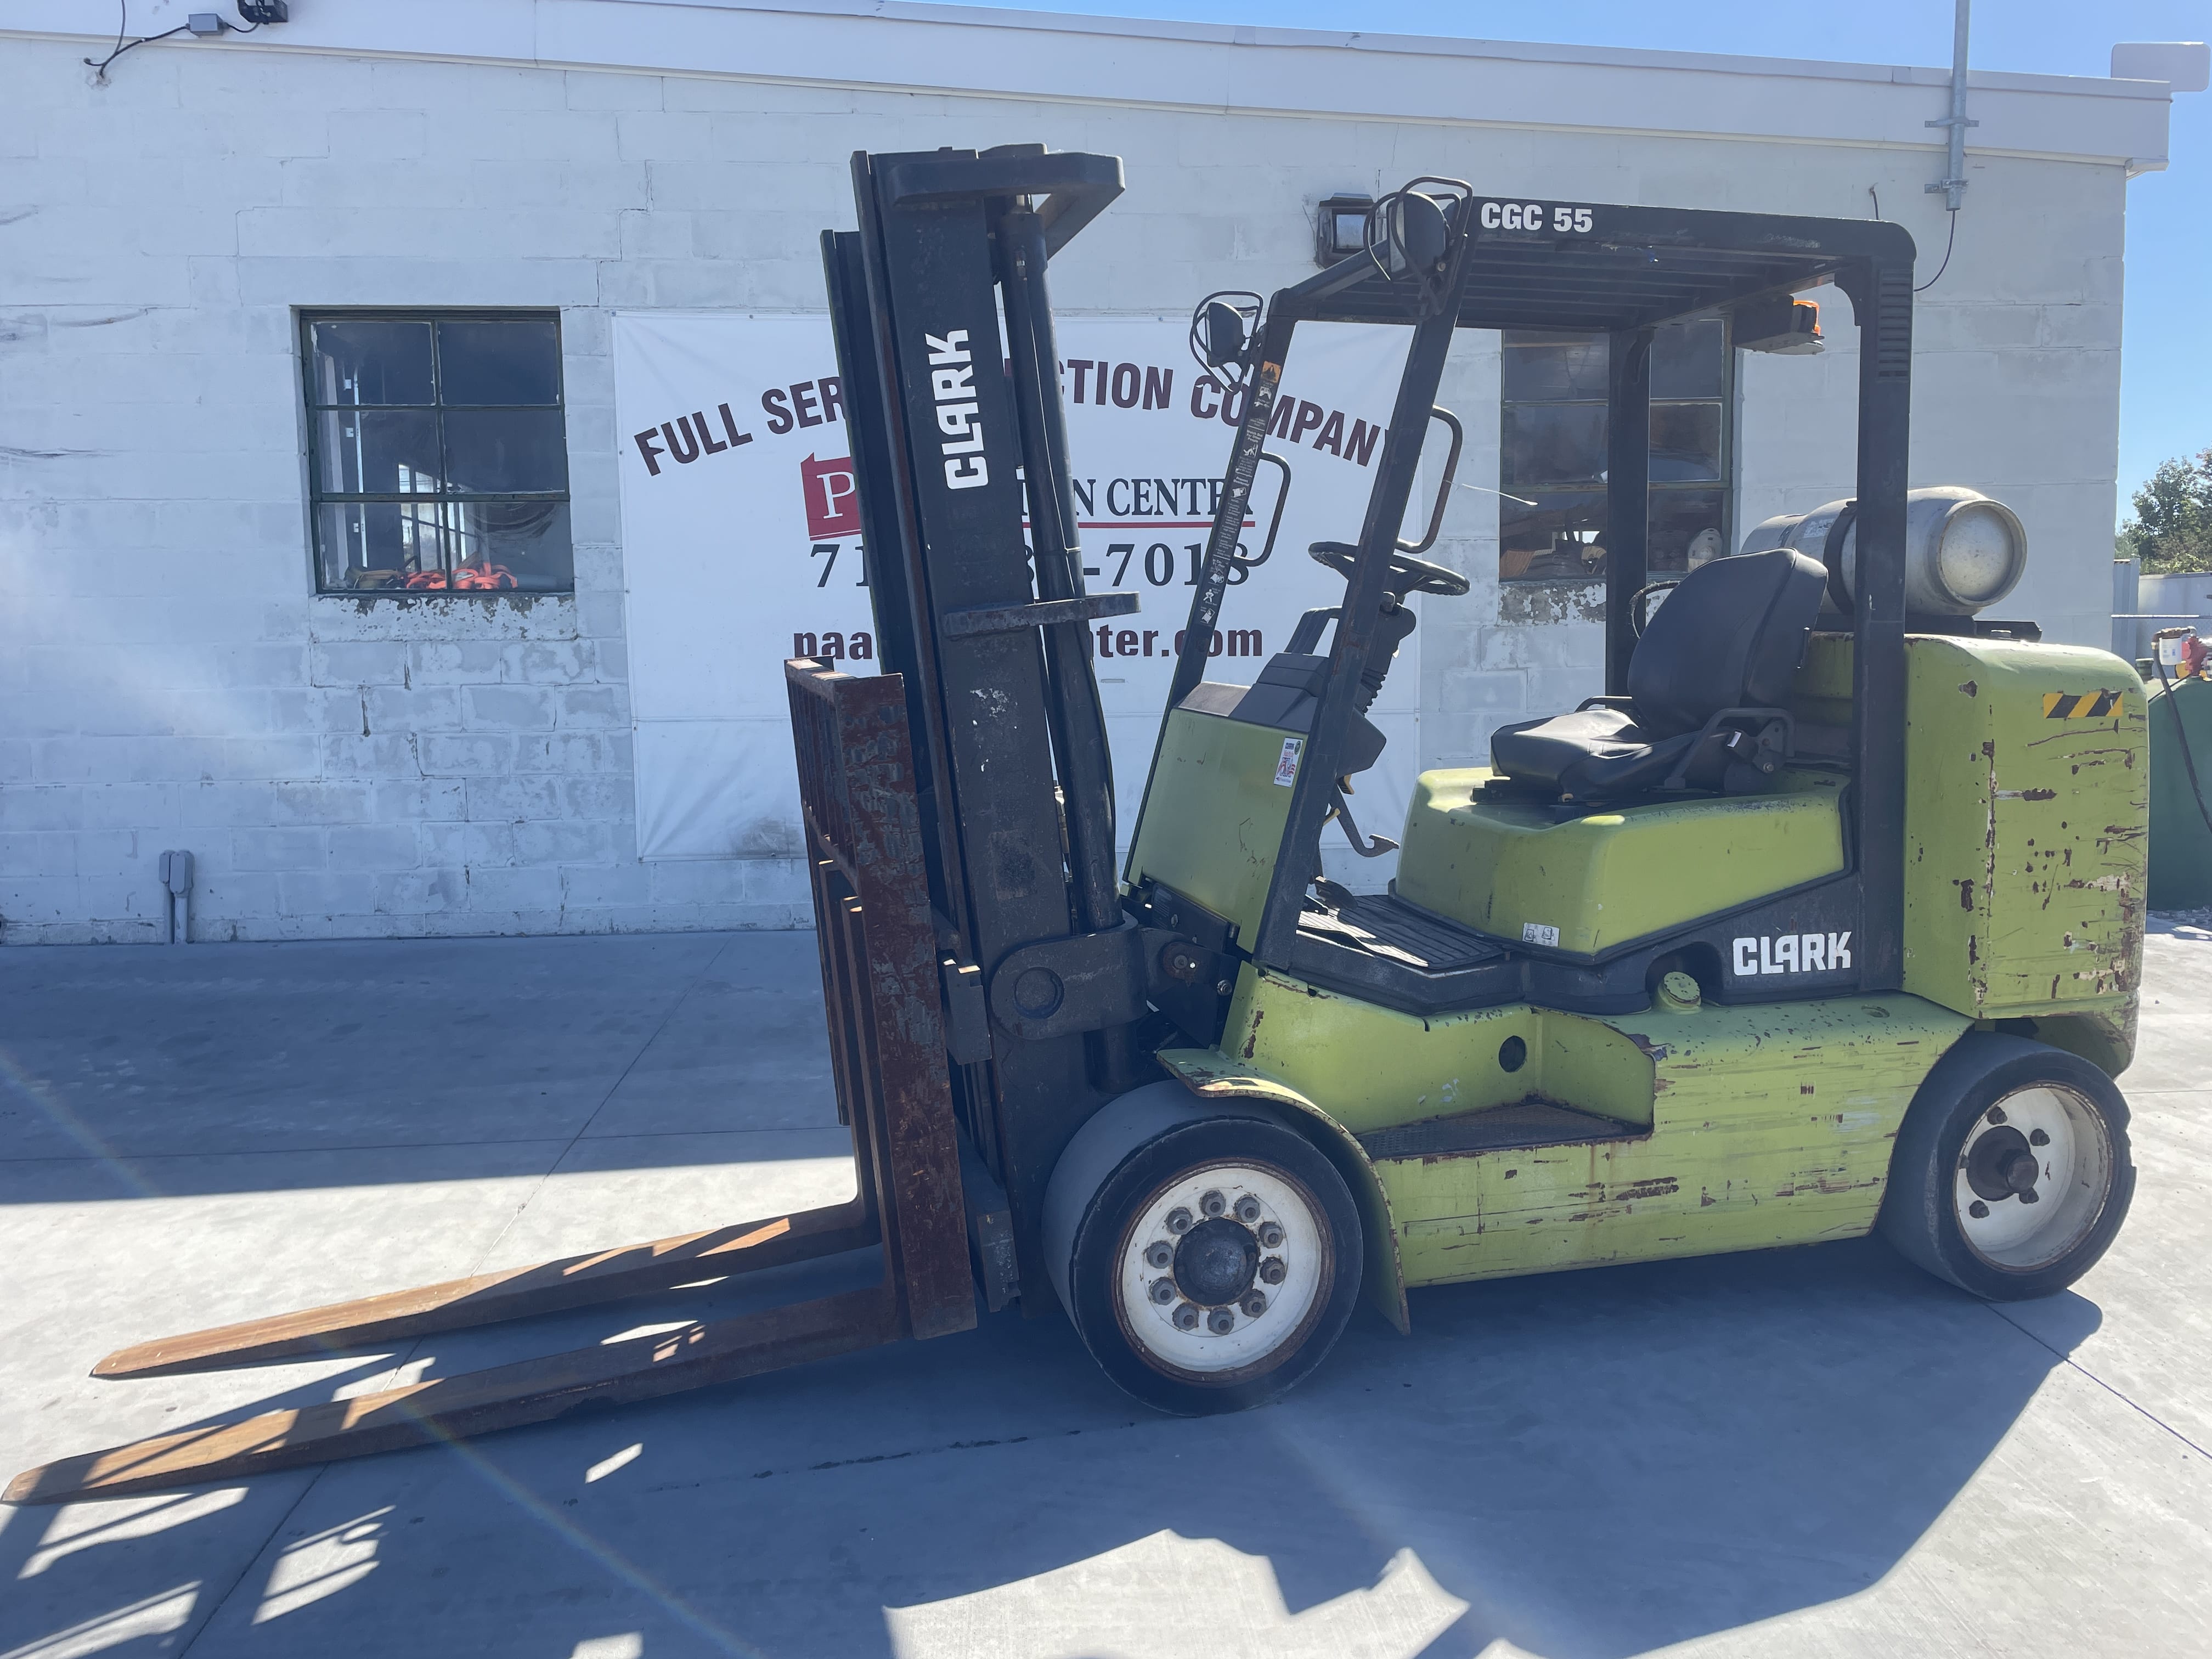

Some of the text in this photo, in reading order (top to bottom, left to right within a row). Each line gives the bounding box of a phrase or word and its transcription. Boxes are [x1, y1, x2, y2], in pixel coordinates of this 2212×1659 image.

[1481, 202, 1593, 233] CGC 55
[634, 403, 753, 476] FULL
[1059, 359, 1173, 410] TION
[1190, 375, 1387, 467] COMPAN
[925, 330, 988, 489] CLARK
[1733, 932, 1852, 976] CLARK
